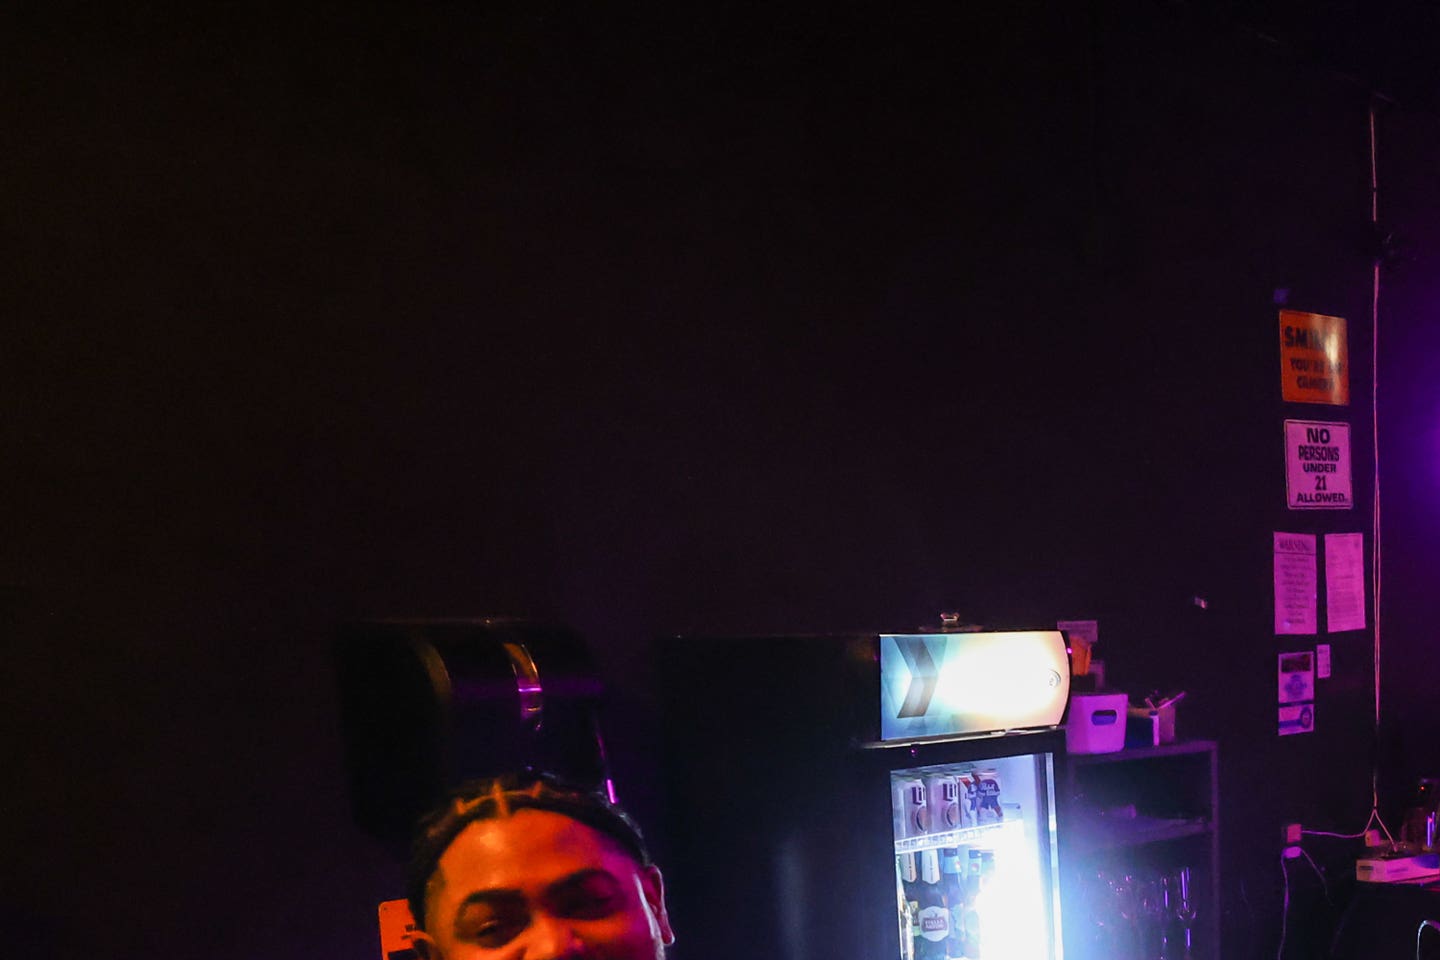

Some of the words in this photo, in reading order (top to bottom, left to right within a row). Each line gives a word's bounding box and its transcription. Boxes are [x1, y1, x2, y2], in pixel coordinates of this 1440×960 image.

[1306, 428, 1330, 444] NO
[1298, 445, 1340, 461] PERSONS
[1303, 463, 1336, 473] UNDER
[1315, 475, 1327, 491] 21
